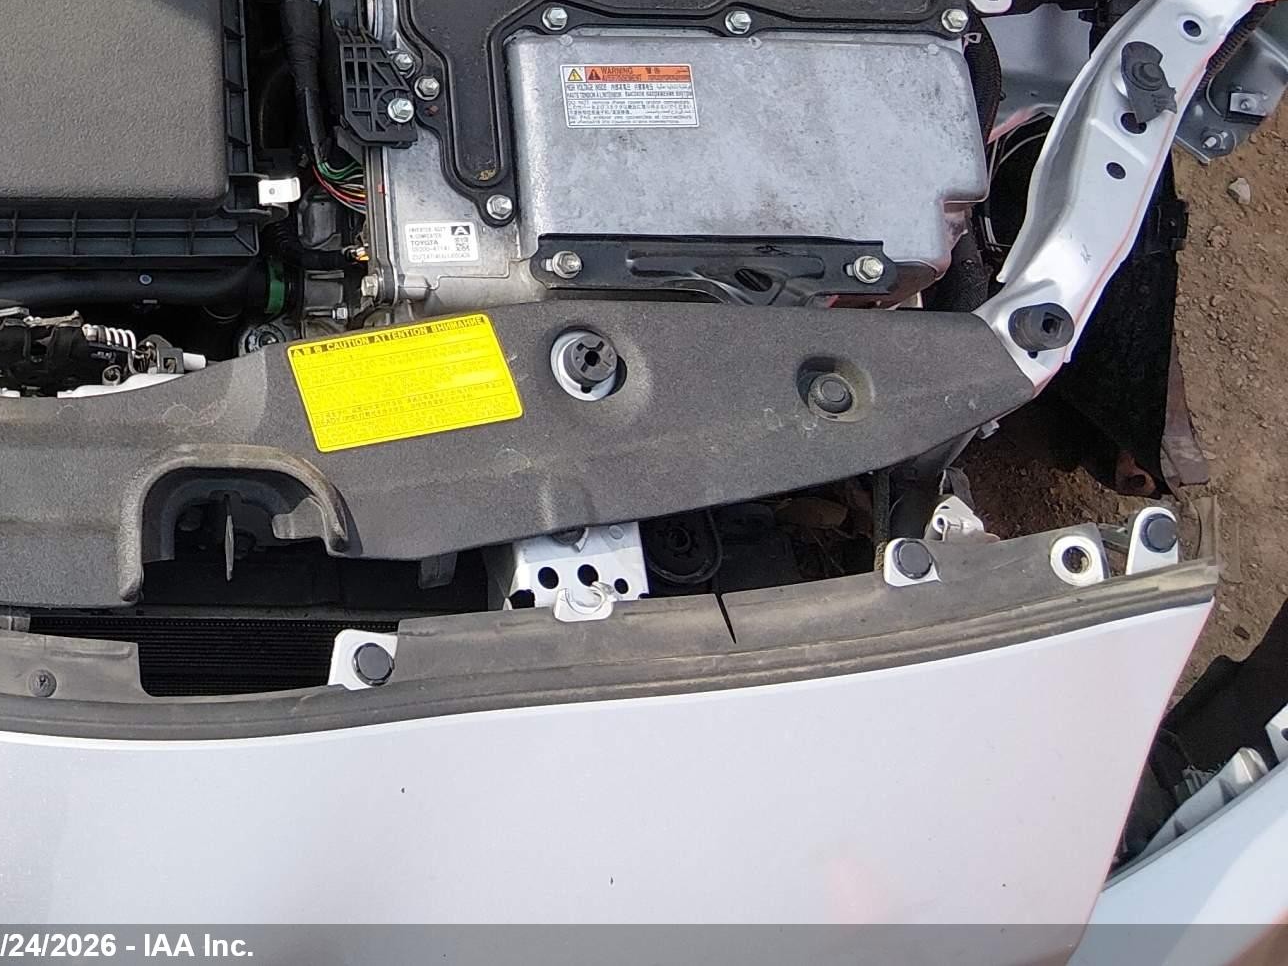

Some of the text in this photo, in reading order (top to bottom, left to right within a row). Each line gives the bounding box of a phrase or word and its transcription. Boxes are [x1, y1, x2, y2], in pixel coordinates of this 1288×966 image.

[601, 67, 633, 75] WARNING
[326, 337, 369, 351] CAUTION
[373, 327, 428, 344] ATTENTION
